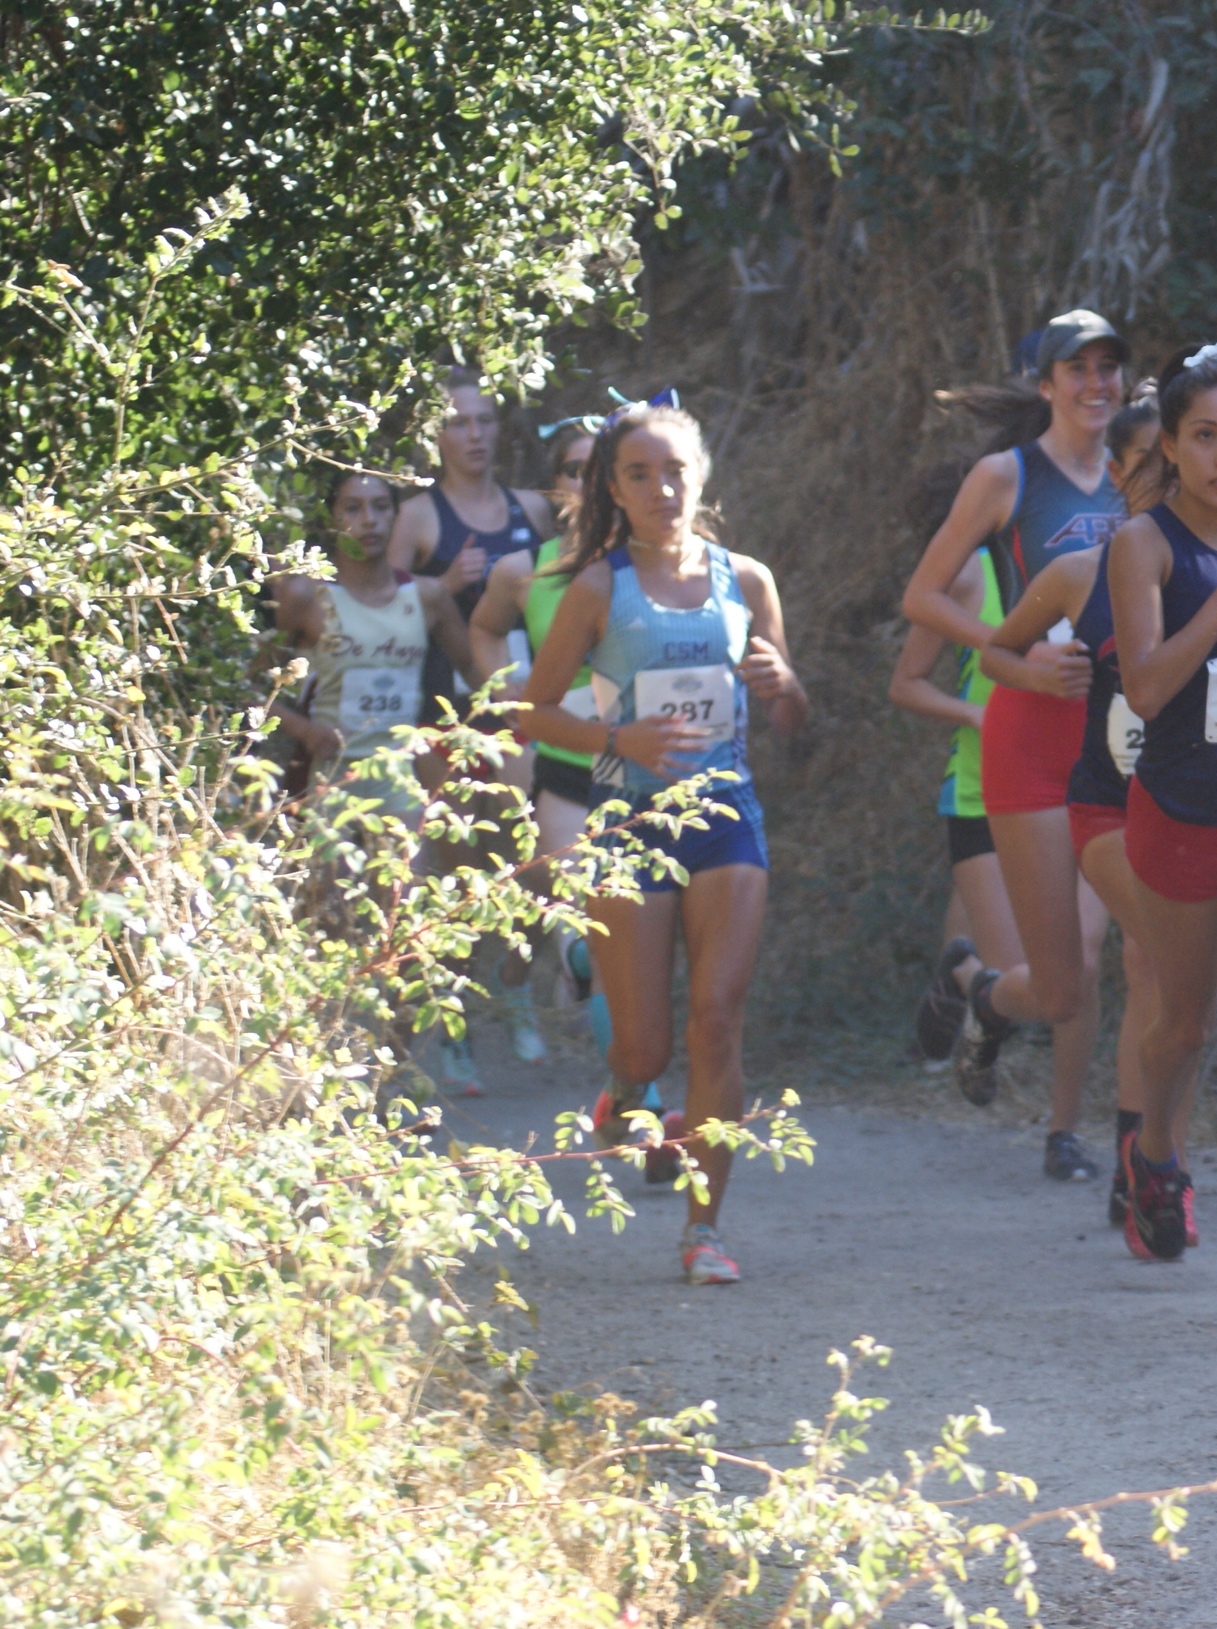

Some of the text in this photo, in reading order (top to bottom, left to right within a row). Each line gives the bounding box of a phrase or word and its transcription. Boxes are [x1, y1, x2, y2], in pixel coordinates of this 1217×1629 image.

[327, 634, 364, 657] De
[663, 641, 709, 660] CSM
[359, 694, 403, 712] 238
[661, 699, 715, 722] 287
